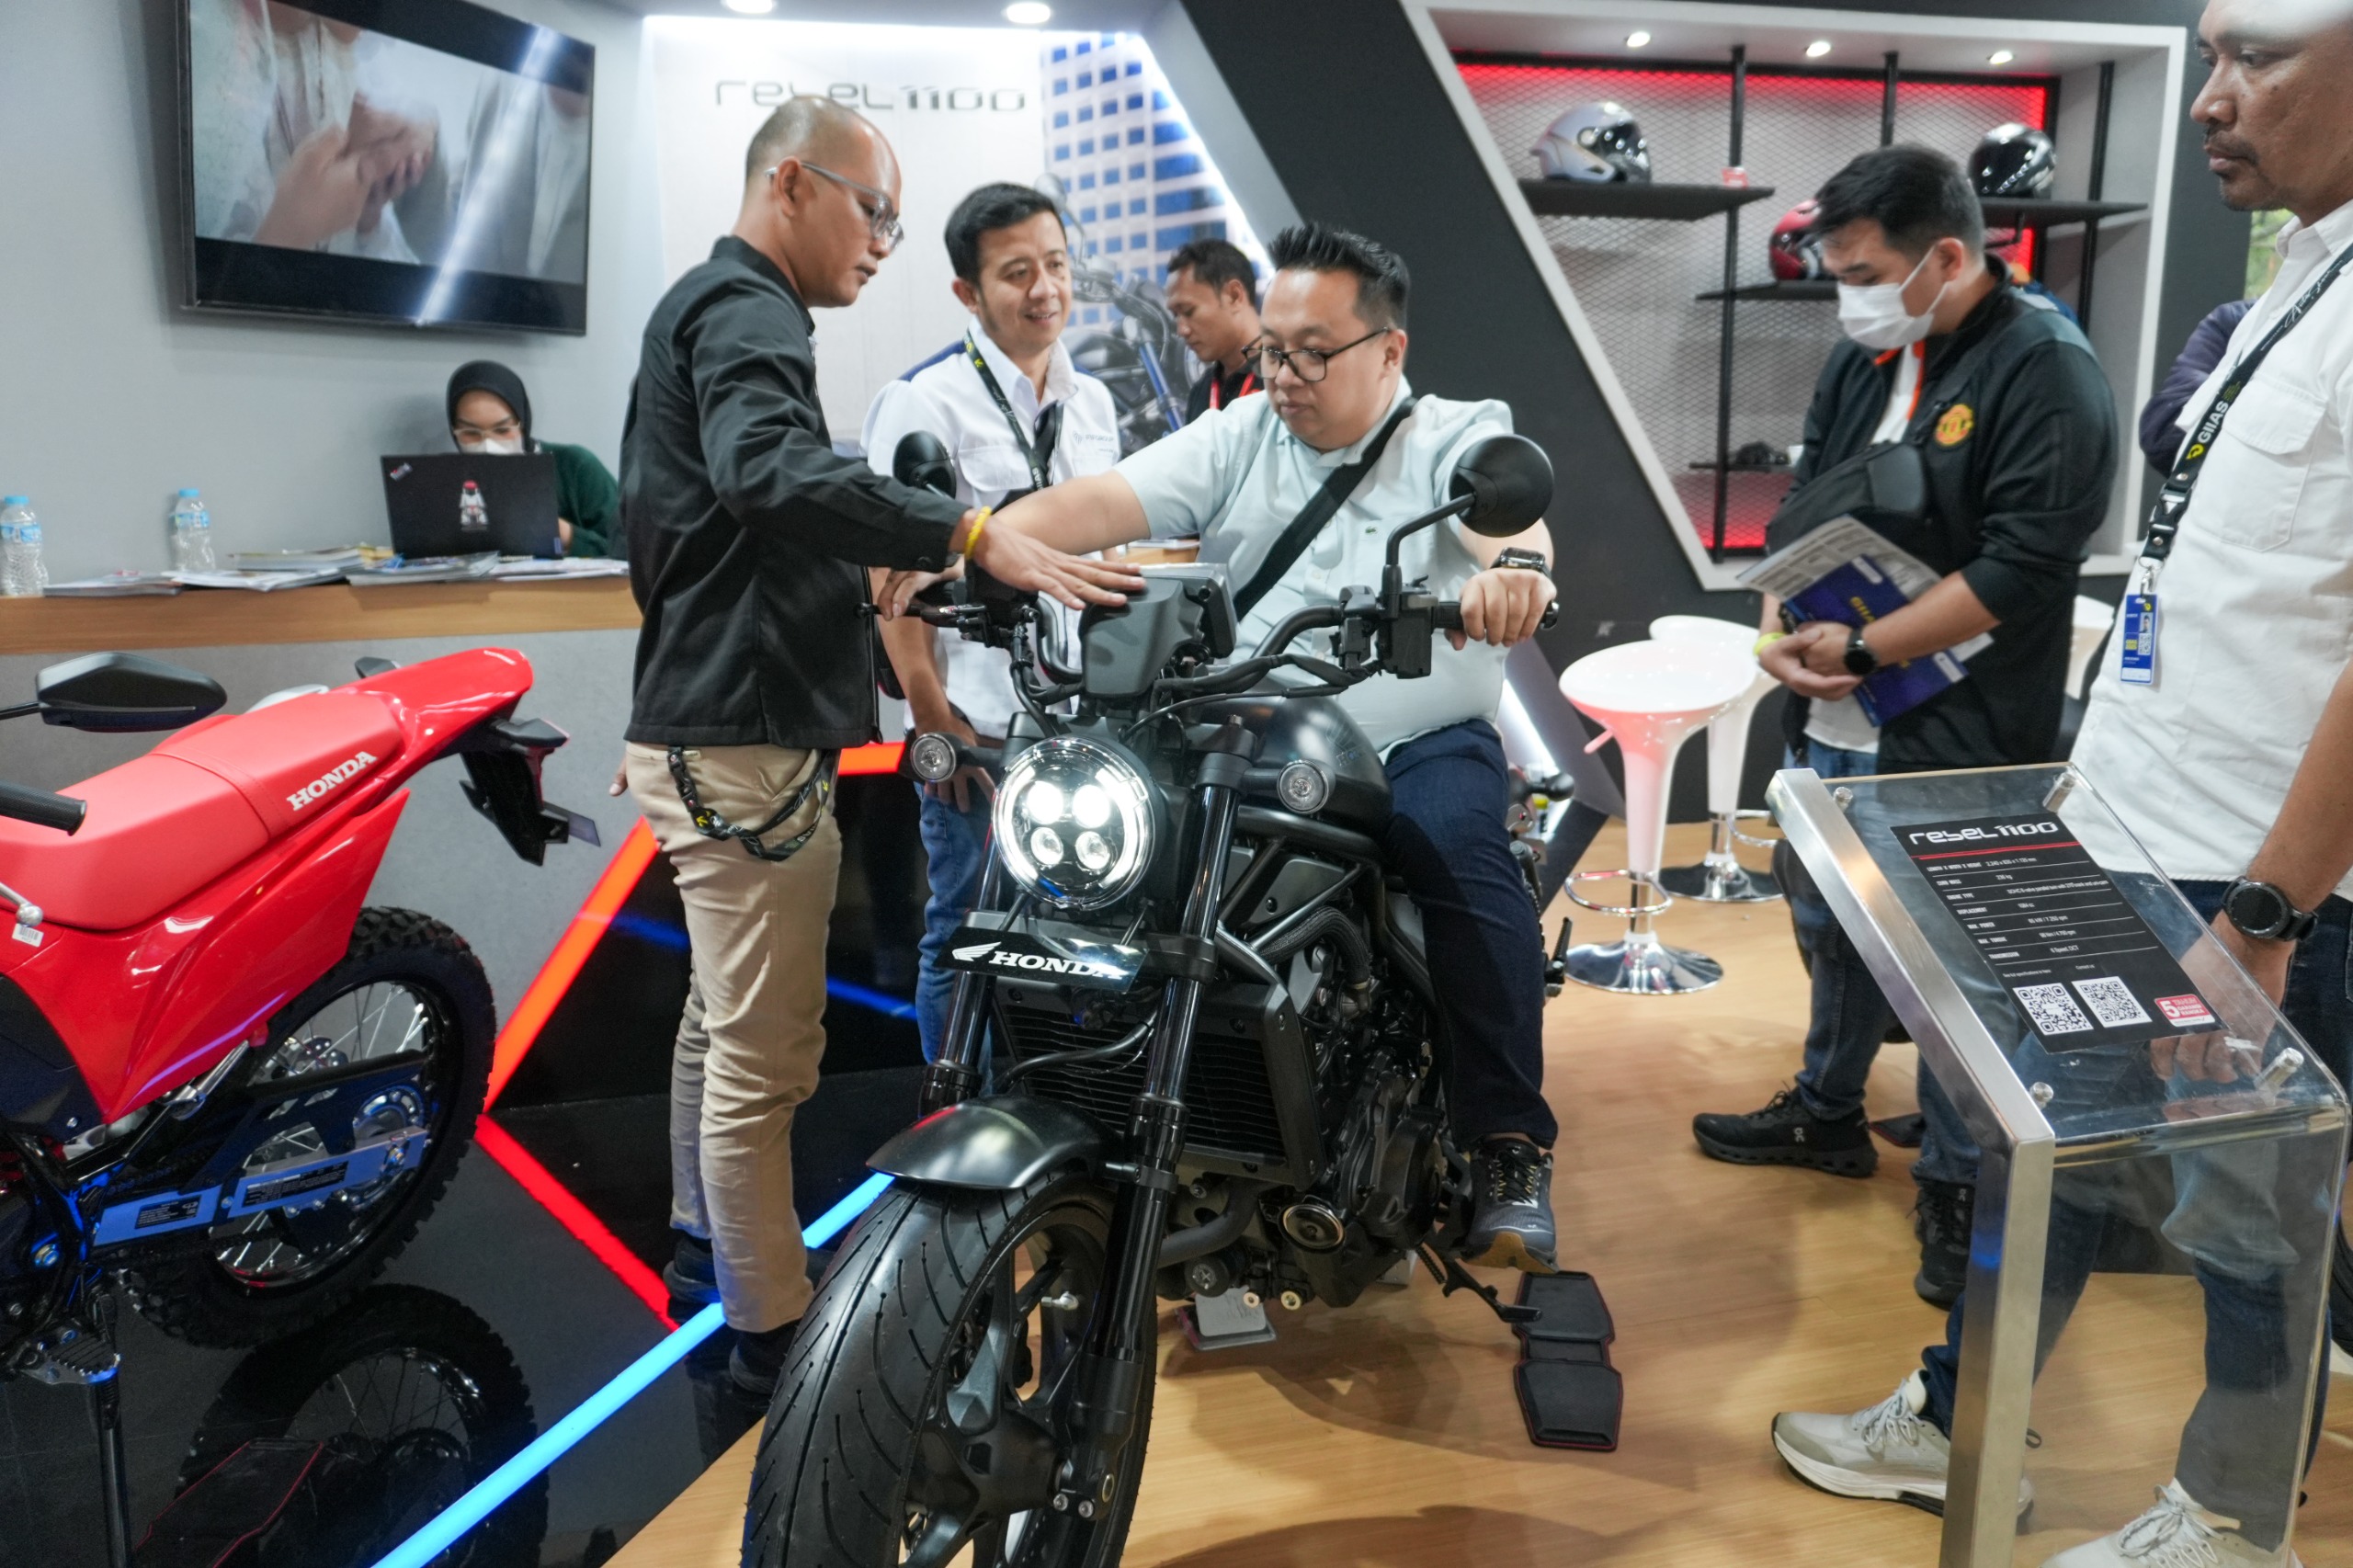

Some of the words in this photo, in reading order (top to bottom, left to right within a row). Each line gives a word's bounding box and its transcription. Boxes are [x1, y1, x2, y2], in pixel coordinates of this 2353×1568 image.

[2198, 400, 2229, 444] GIIAS
[286, 751, 378, 812] HONDA
[989, 950, 1125, 980] HONDA
[2160, 1000, 2181, 1017] 5
